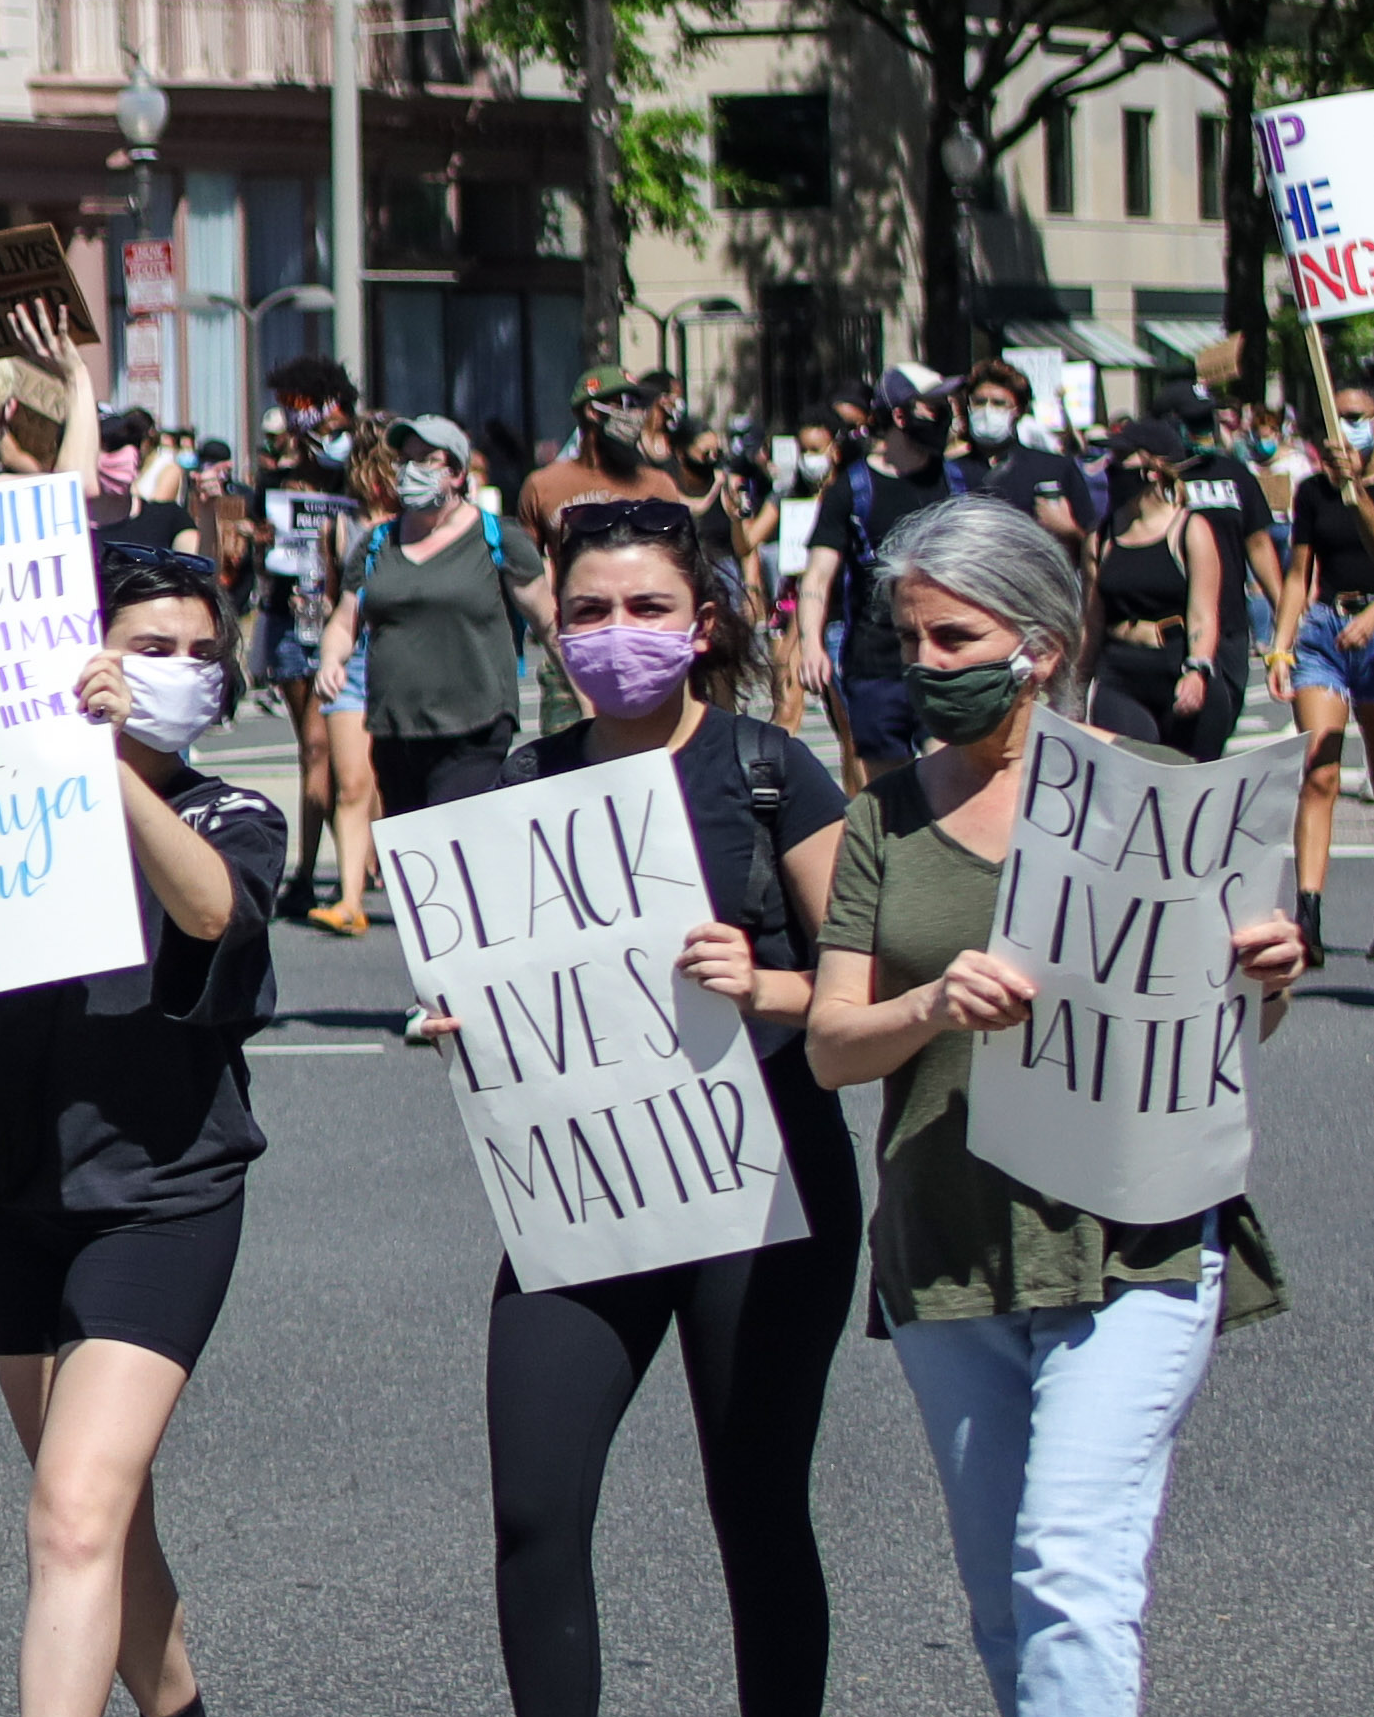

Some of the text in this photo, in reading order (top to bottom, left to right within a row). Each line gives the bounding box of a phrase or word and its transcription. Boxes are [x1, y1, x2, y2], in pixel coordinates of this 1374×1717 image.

[20, 609, 102, 651] MAY
[389, 788, 696, 963] BLACK
[1024, 731, 1271, 881] BLACK
[1003, 848, 1244, 997] LIVES
[436, 947, 680, 1093] LIVES
[484, 1077, 781, 1236] MATTER
